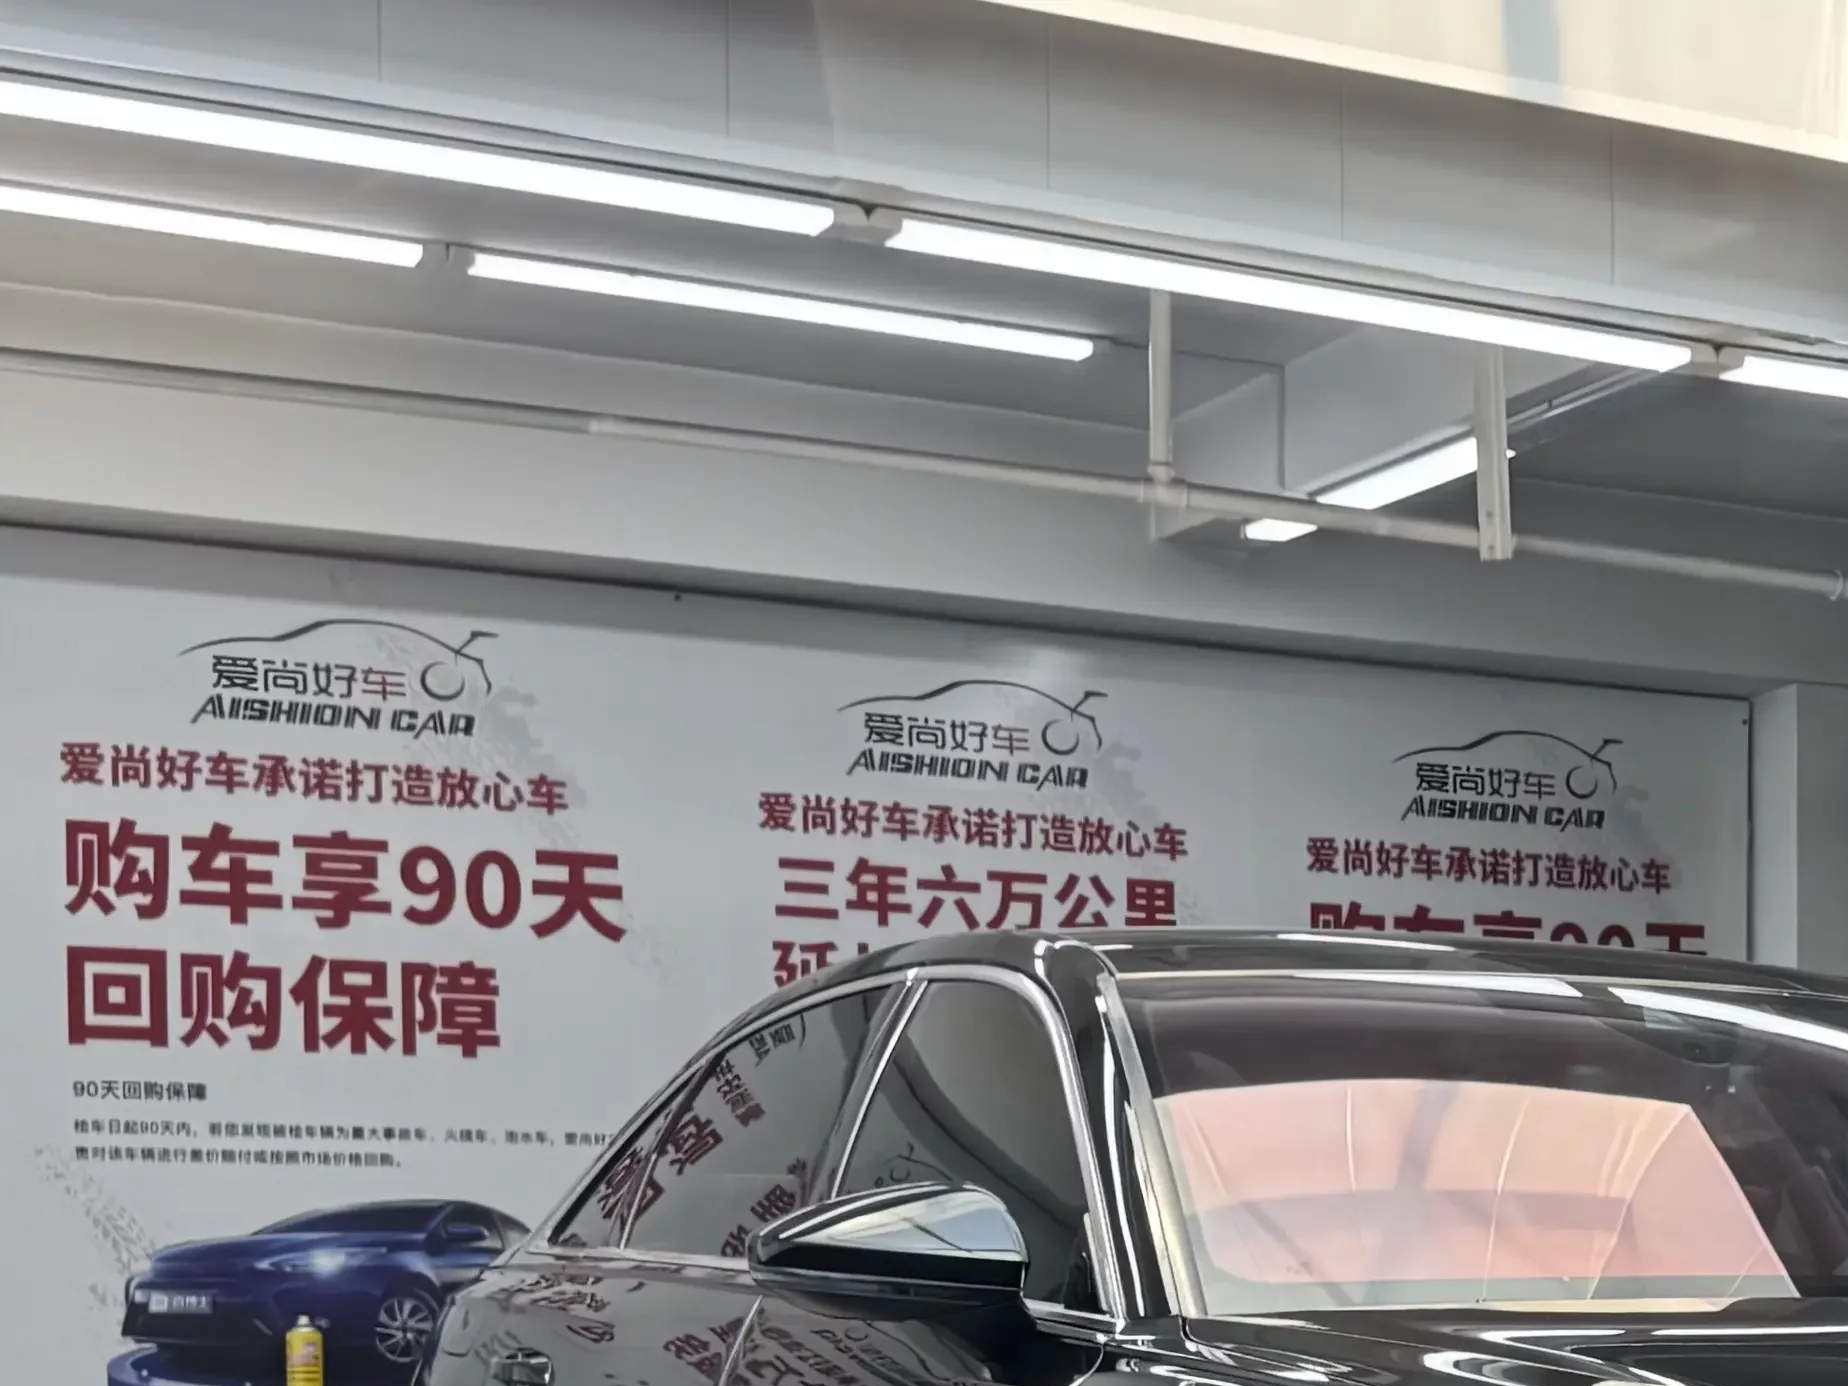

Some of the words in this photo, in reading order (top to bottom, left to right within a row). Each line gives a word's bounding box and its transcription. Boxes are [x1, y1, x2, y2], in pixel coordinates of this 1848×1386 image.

[211, 655, 408, 701] 爱尚好车
[389, 709, 476, 739] CAR
[864, 712, 1031, 756] 爱尚好车
[60, 741, 571, 816] 爱尚好车承诺打造放心车
[1016, 763, 1089, 791] CAR
[1415, 762, 1556, 802] 爱尚好车
[758, 791, 1190, 862] 爱尚好车承诺打造放心车
[1544, 806, 1606, 833] CAR
[63, 817, 627, 944] 购车享90天
[1306, 836, 1671, 894] 爱尚好车承诺打造放心车
[775, 856, 1178, 930] 三年六万公里
[65, 944, 501, 1059] 回购保障
[72, 1080, 208, 1102] 90天回购保障
